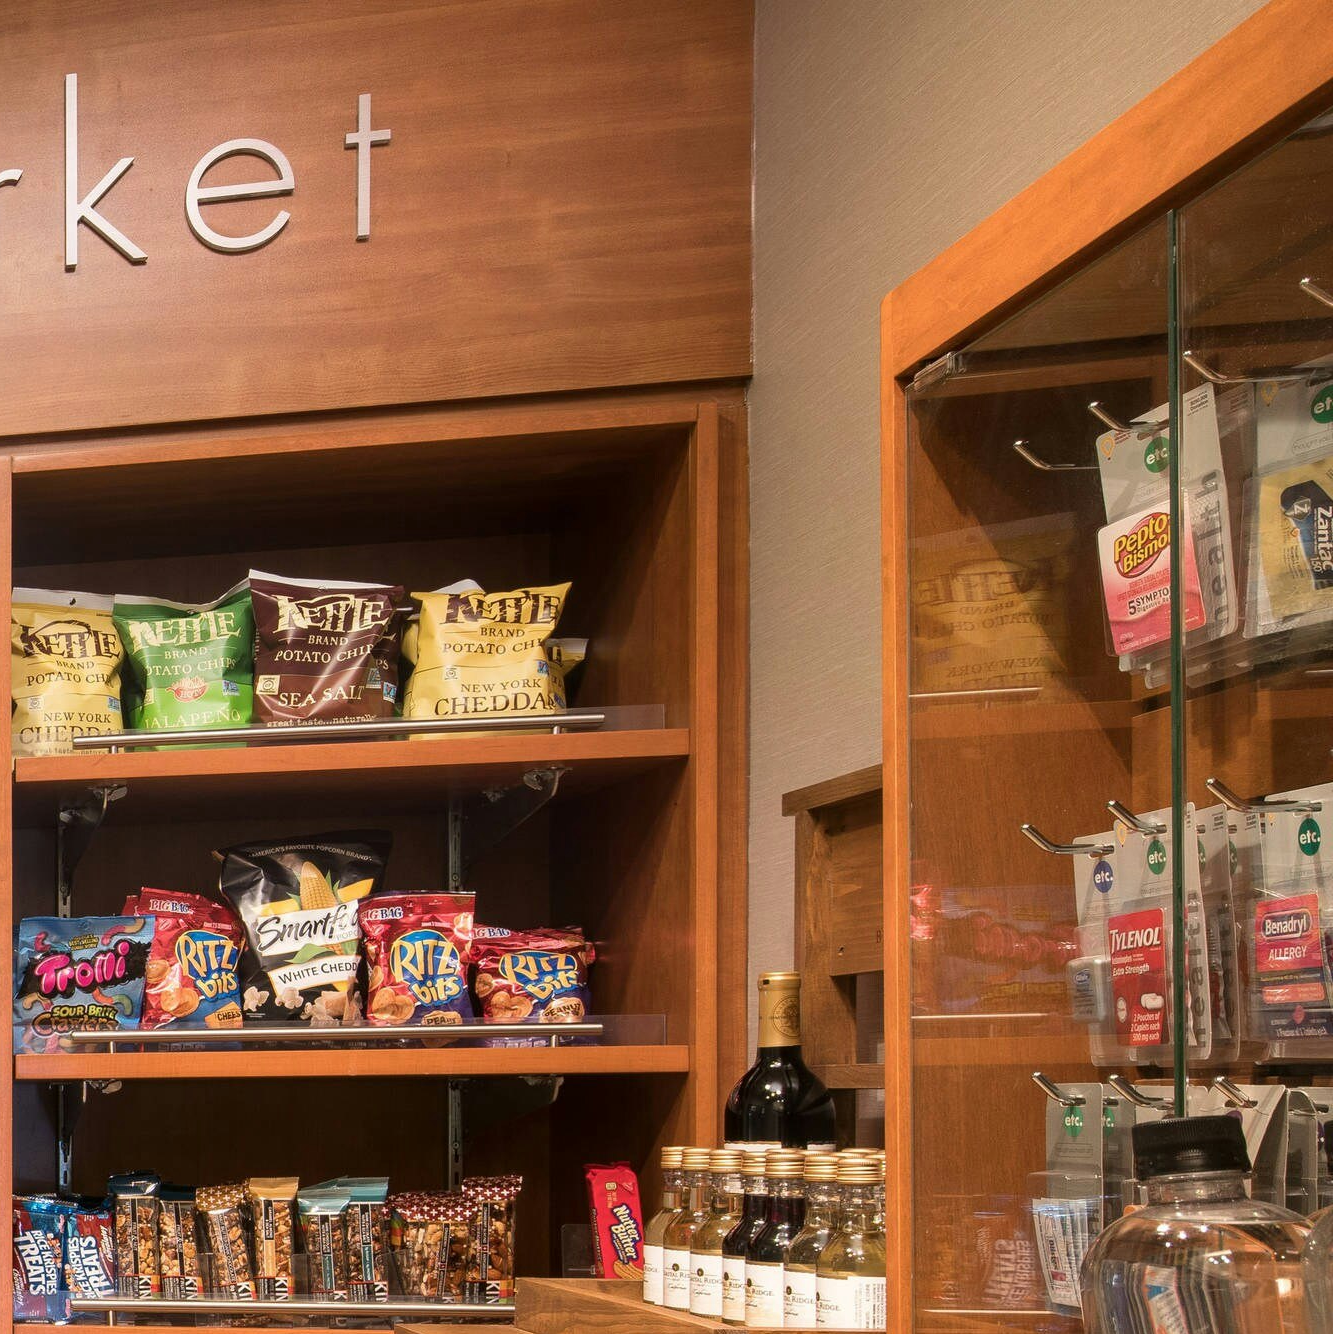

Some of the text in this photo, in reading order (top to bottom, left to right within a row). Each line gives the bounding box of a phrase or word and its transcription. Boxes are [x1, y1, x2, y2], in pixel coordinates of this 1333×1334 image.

[1122, 526, 1171, 578] Bismo
[272, 594, 391, 634] KETTLE
[1299, 830, 1321, 845] etc.
[1148, 852, 1166, 864] etc.
[1094, 872, 1113, 884] etc.
[149, 899, 191, 914] BIG BAG
[1265, 914, 1307, 938] Benadryl
[1109, 927, 1162, 950] TYLENOL
[392, 938, 459, 982] RITZ
[1268, 946, 1307, 961] ALLERGY
[35, 941, 130, 994] Trolli
[279, 966, 320, 984] WHITE
[1112, 962, 1150, 977] Extra Strength
[414, 975, 464, 1004] bits
[52, 1005, 119, 1019] SOUR BRITE
[613, 1205, 639, 1241] Nutter
[611, 1225, 637, 1259] Butter
[13, 1232, 45, 1296] TREATS
